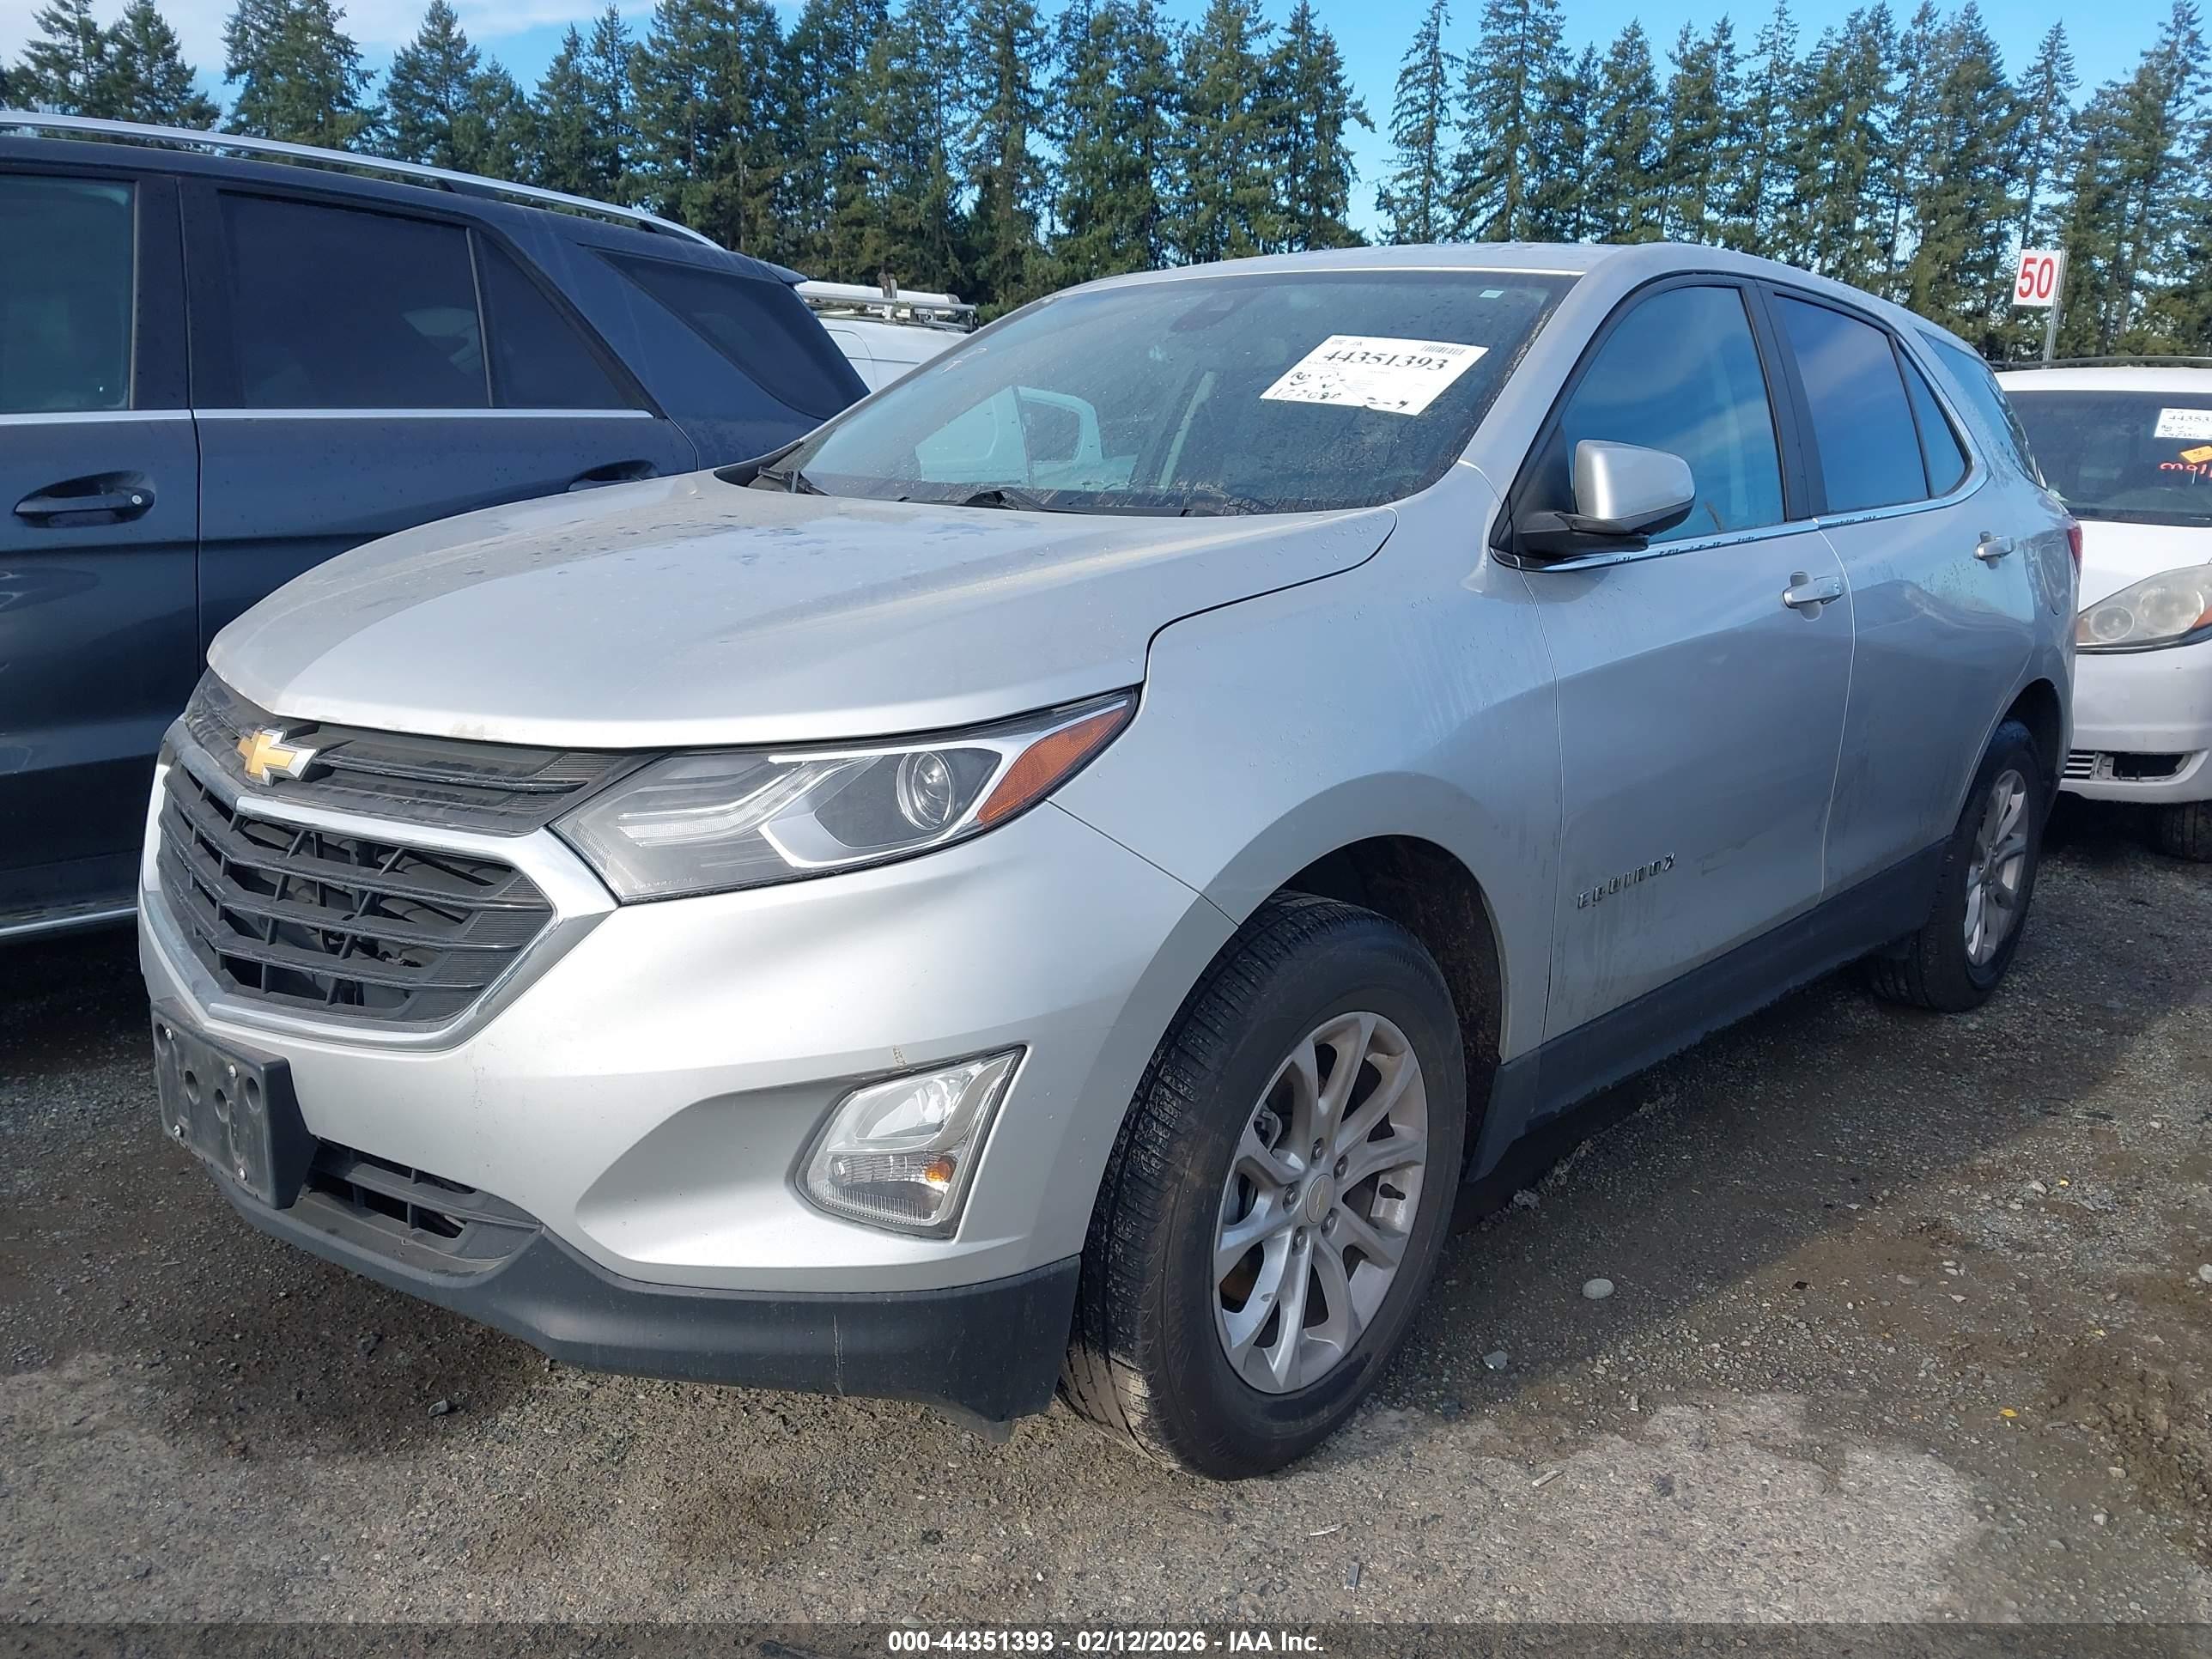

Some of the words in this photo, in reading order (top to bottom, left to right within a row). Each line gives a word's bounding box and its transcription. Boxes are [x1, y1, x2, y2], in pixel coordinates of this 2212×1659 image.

[2019, 258, 2054, 299] 50
[1323, 349, 1449, 371] 44351393
[1577, 852, 1676, 908] EQUINOX
